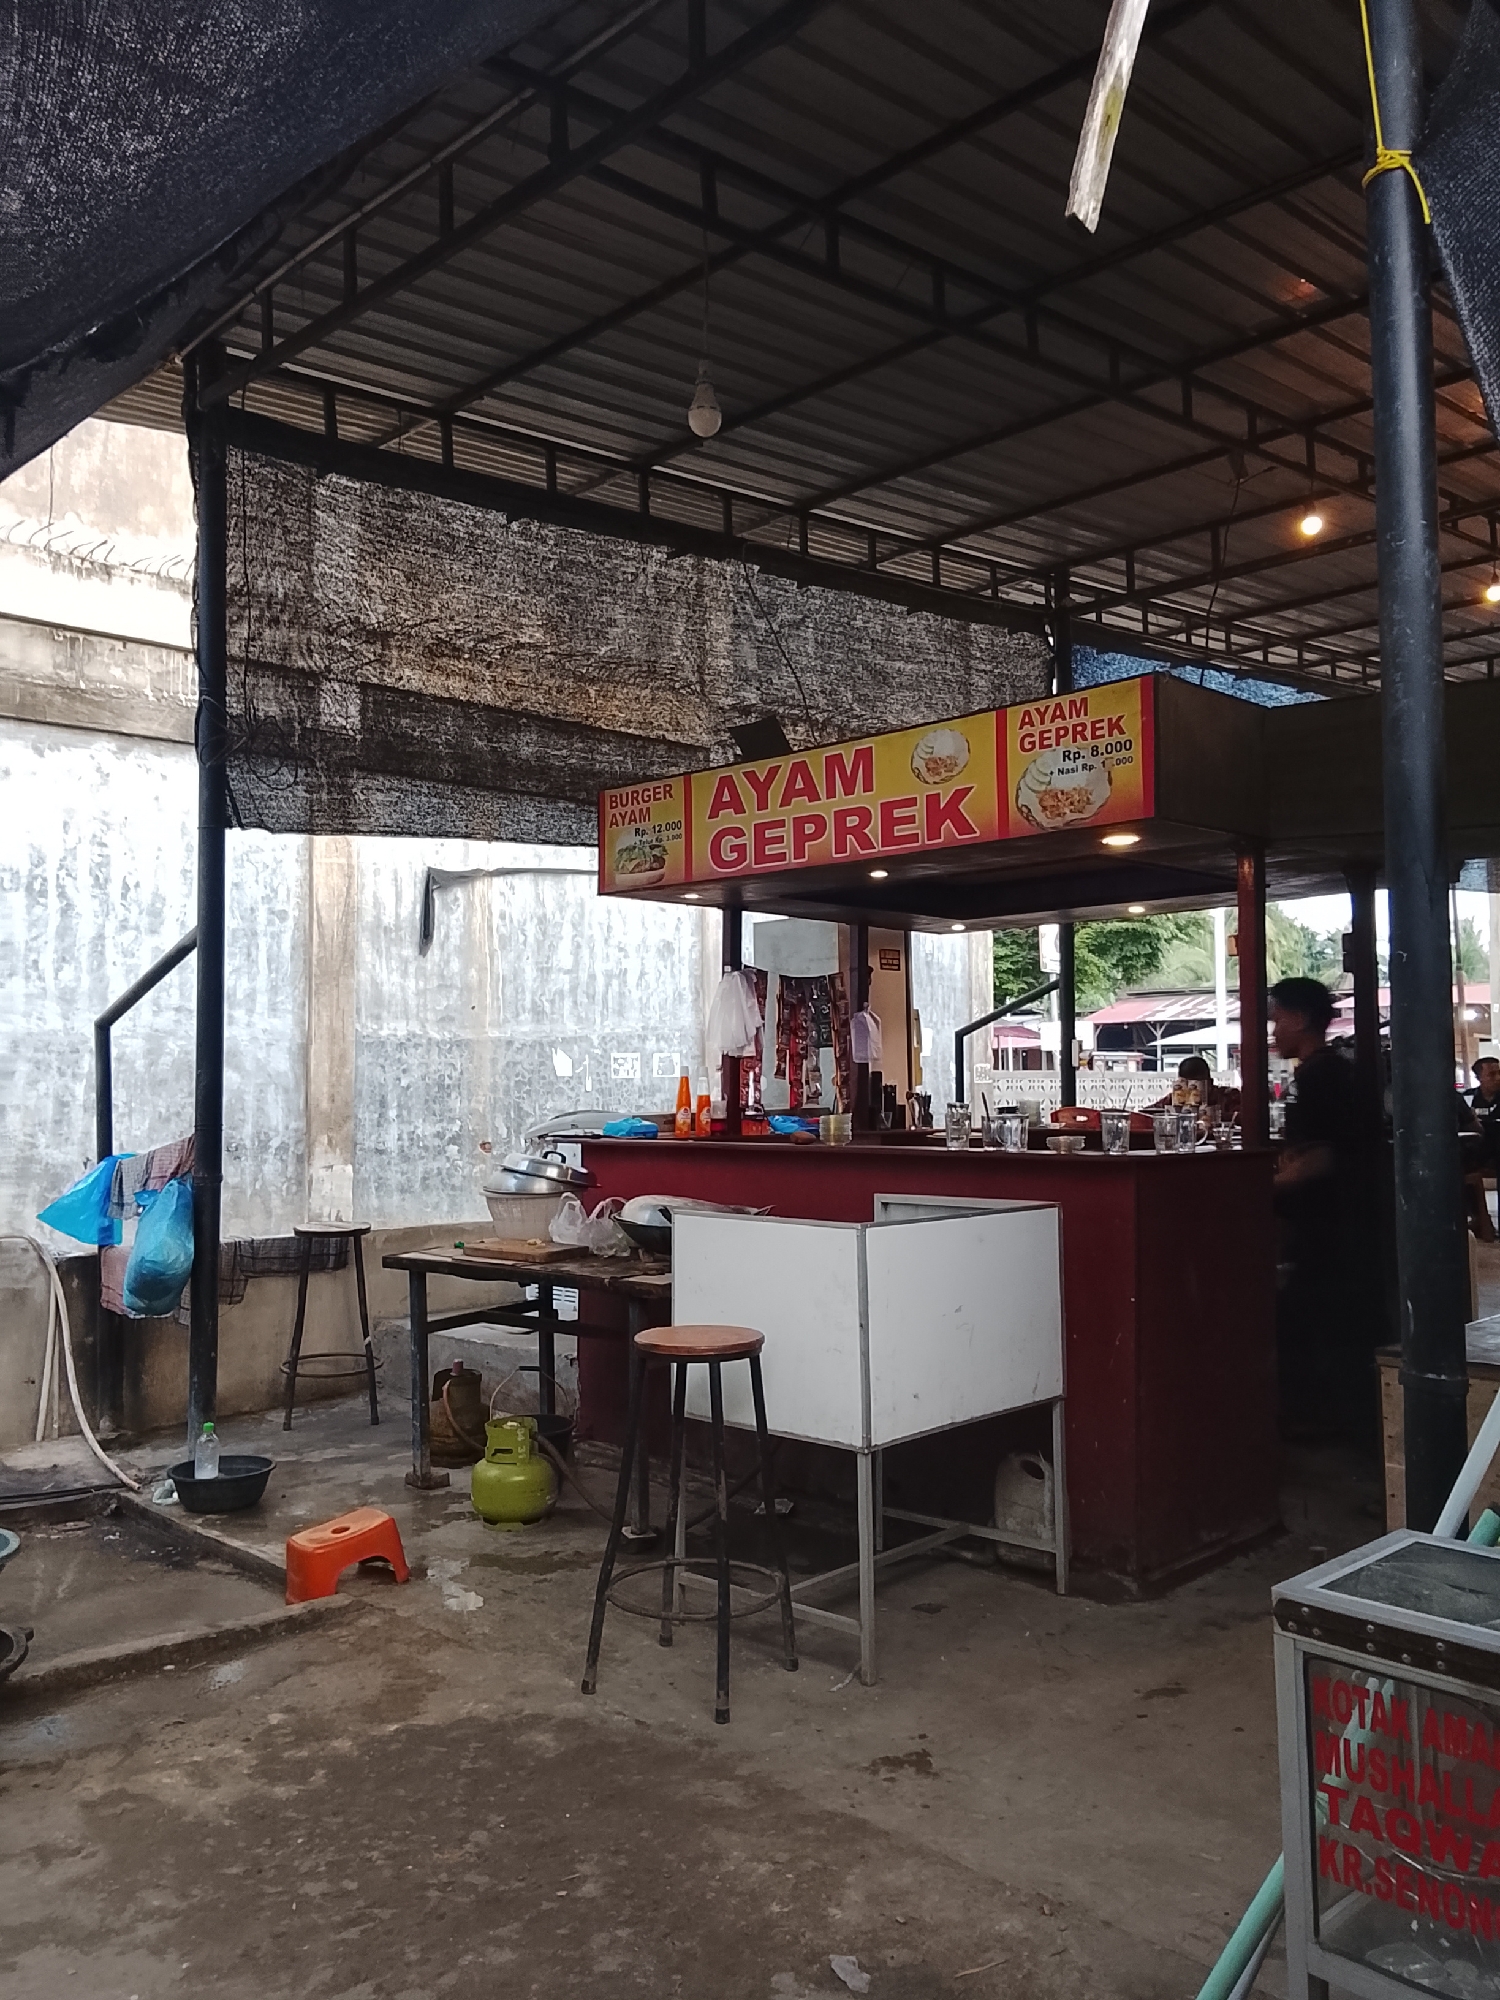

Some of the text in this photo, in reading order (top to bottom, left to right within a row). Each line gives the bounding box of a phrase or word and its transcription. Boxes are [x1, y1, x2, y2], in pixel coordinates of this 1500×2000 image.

[1018, 696, 1089, 731] AYAM
[1019, 714, 1126, 753] GEPREK
[1062, 738, 1133, 763] Rp. 8.000
[707, 745, 875, 820] AYAM
[1057, 764, 1079, 776] Nasi
[1081, 762, 1097, 773] Rp.
[1100, 755, 1134, 769] 1.000
[609, 784, 673, 809] BURGER
[608, 806, 651, 829] AYAM
[635, 820, 682, 838] Rp. 12.000
[709, 785, 978, 871] GEPREK
[1312, 1675, 1411, 1743] KOTAK
[1318, 1781, 1500, 1880] TAQWA
[1319, 1834, 1500, 1943] KR.SENON
